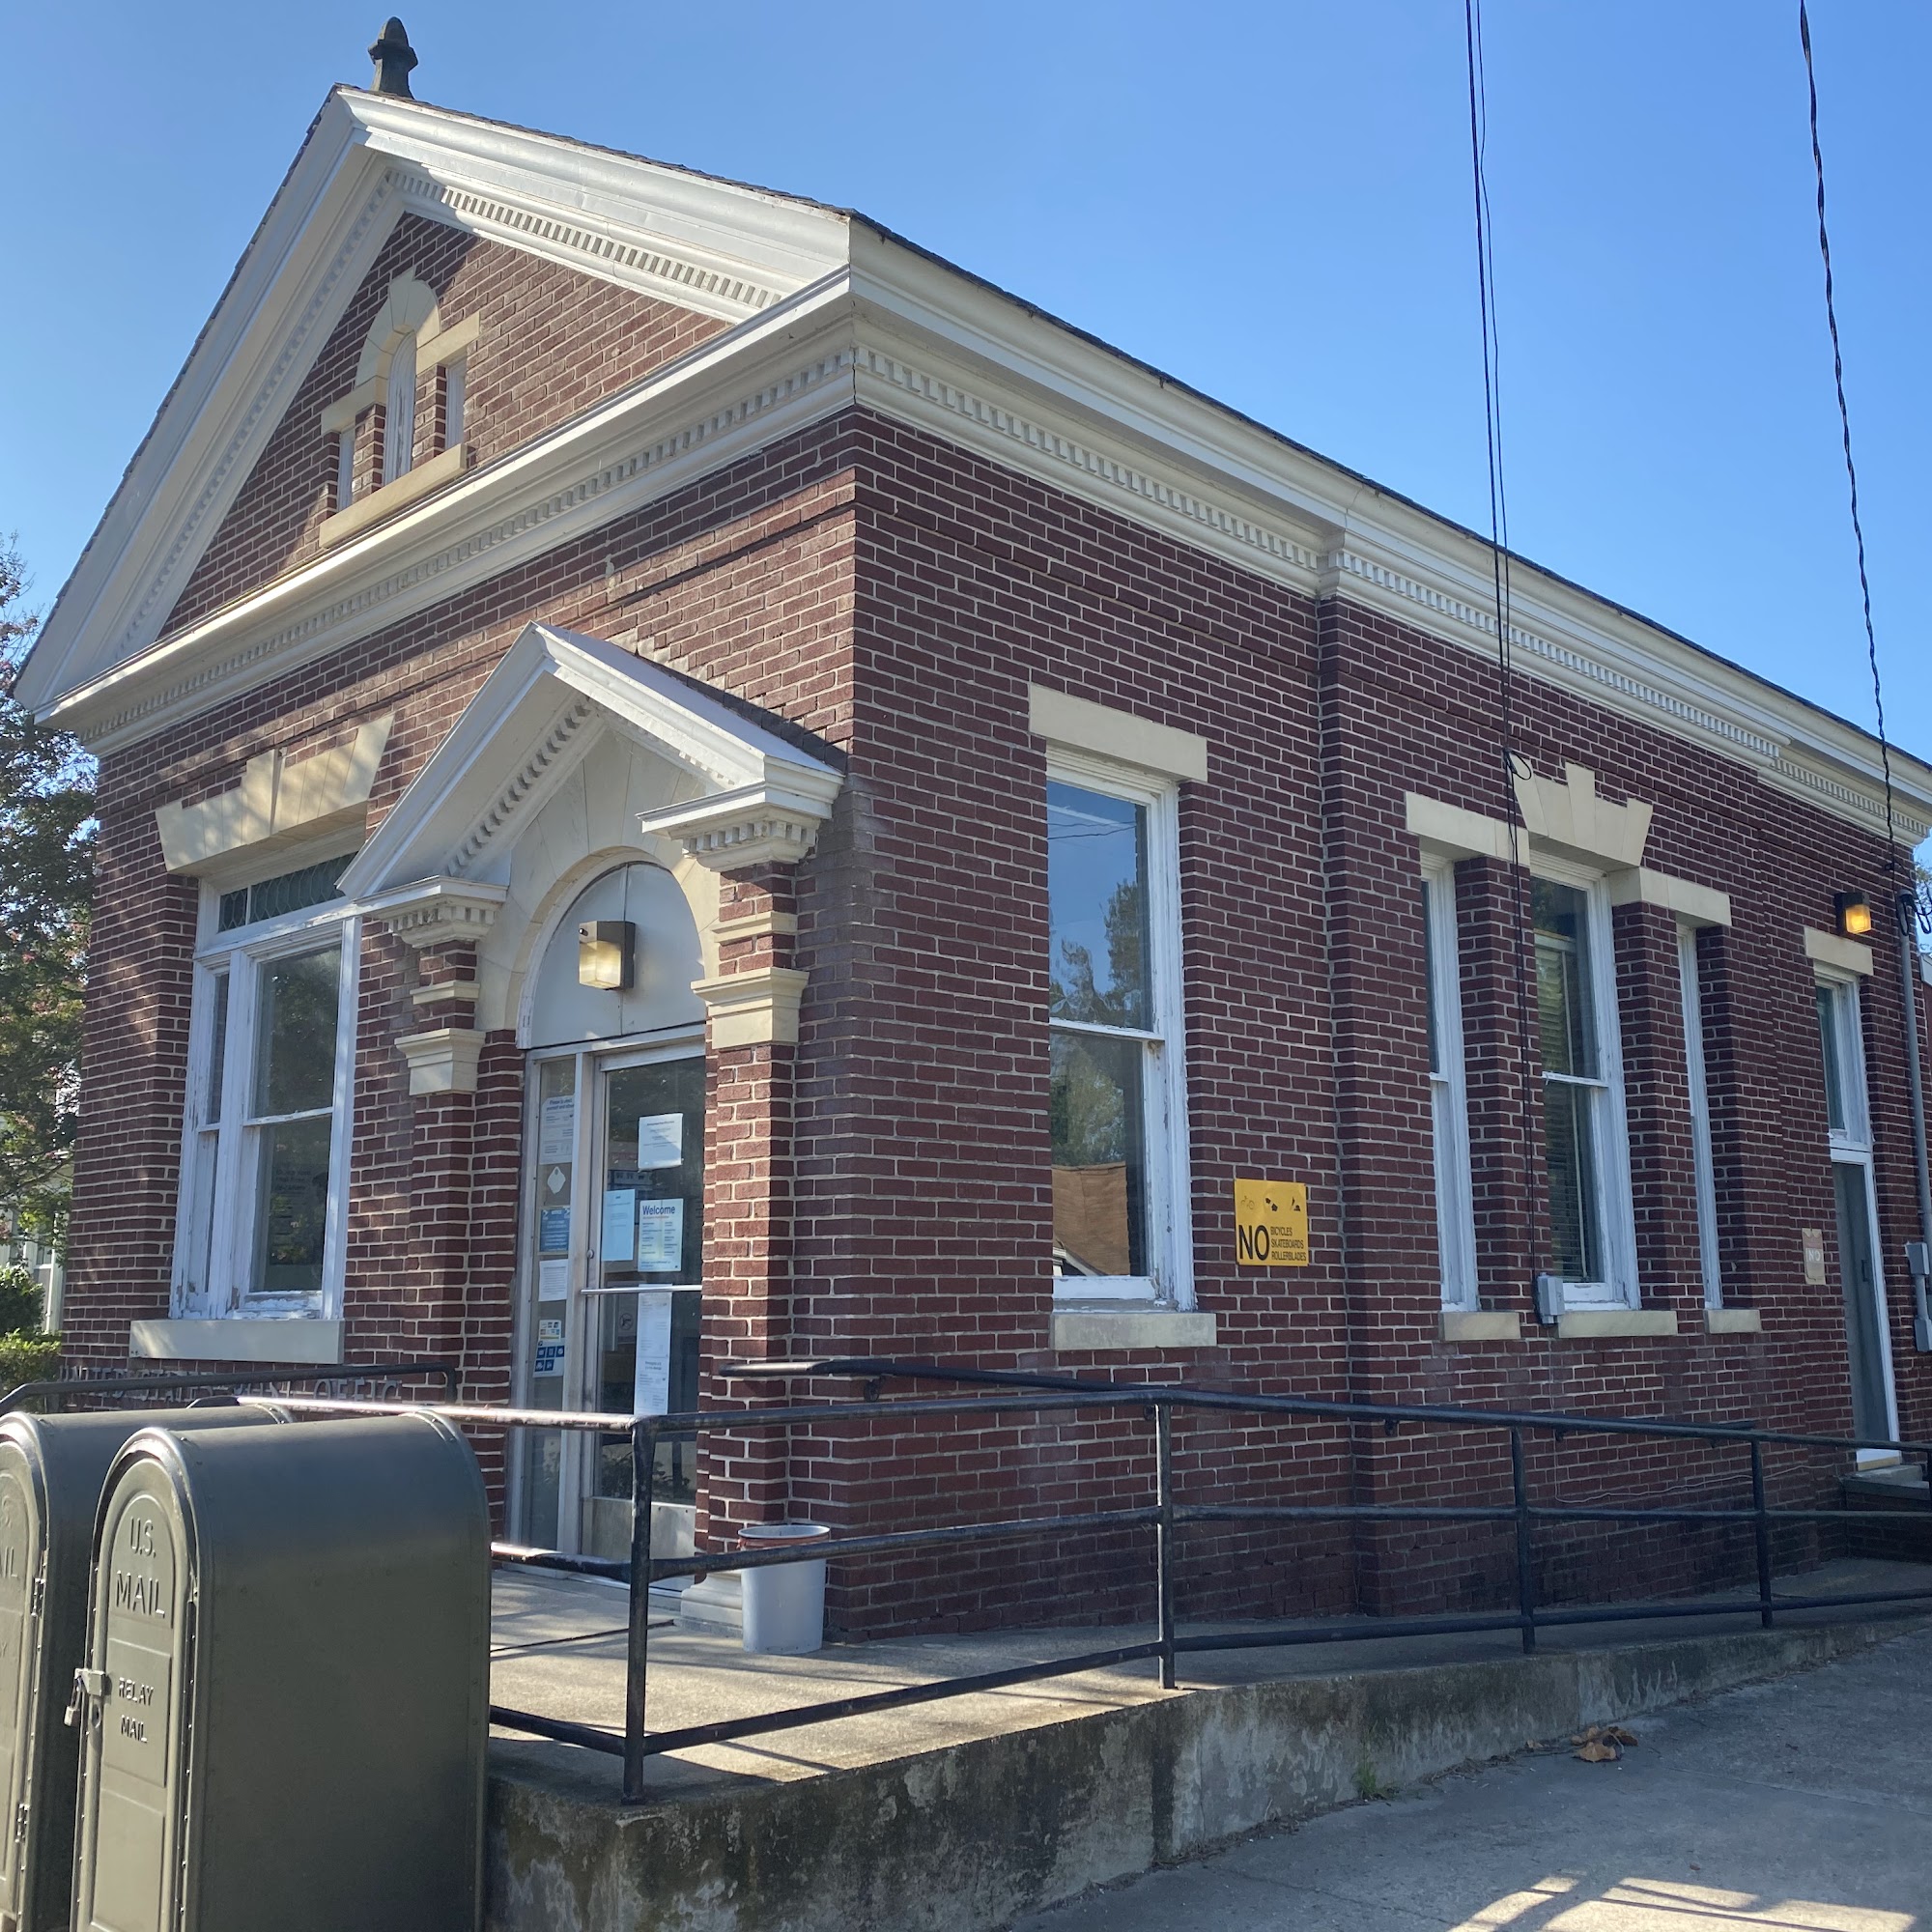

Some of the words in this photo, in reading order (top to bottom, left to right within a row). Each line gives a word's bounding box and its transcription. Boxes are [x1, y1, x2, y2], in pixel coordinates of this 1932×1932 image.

[642, 1205, 676, 1215] Welcome
[1238, 1224, 1270, 1261] NO
[1270, 1226, 1293, 1236] BICYCLES
[1270, 1237, 1304, 1250] SKATEBOARDS
[1271, 1251, 1307, 1262] ROLLERBLADES
[312, 1378, 399, 1404] OFFIC
[129, 1516, 156, 1559] U.S.
[115, 1570, 165, 1619] MAIL
[118, 1677, 154, 1706] RELAY
[120, 1714, 148, 1743] MAIL
